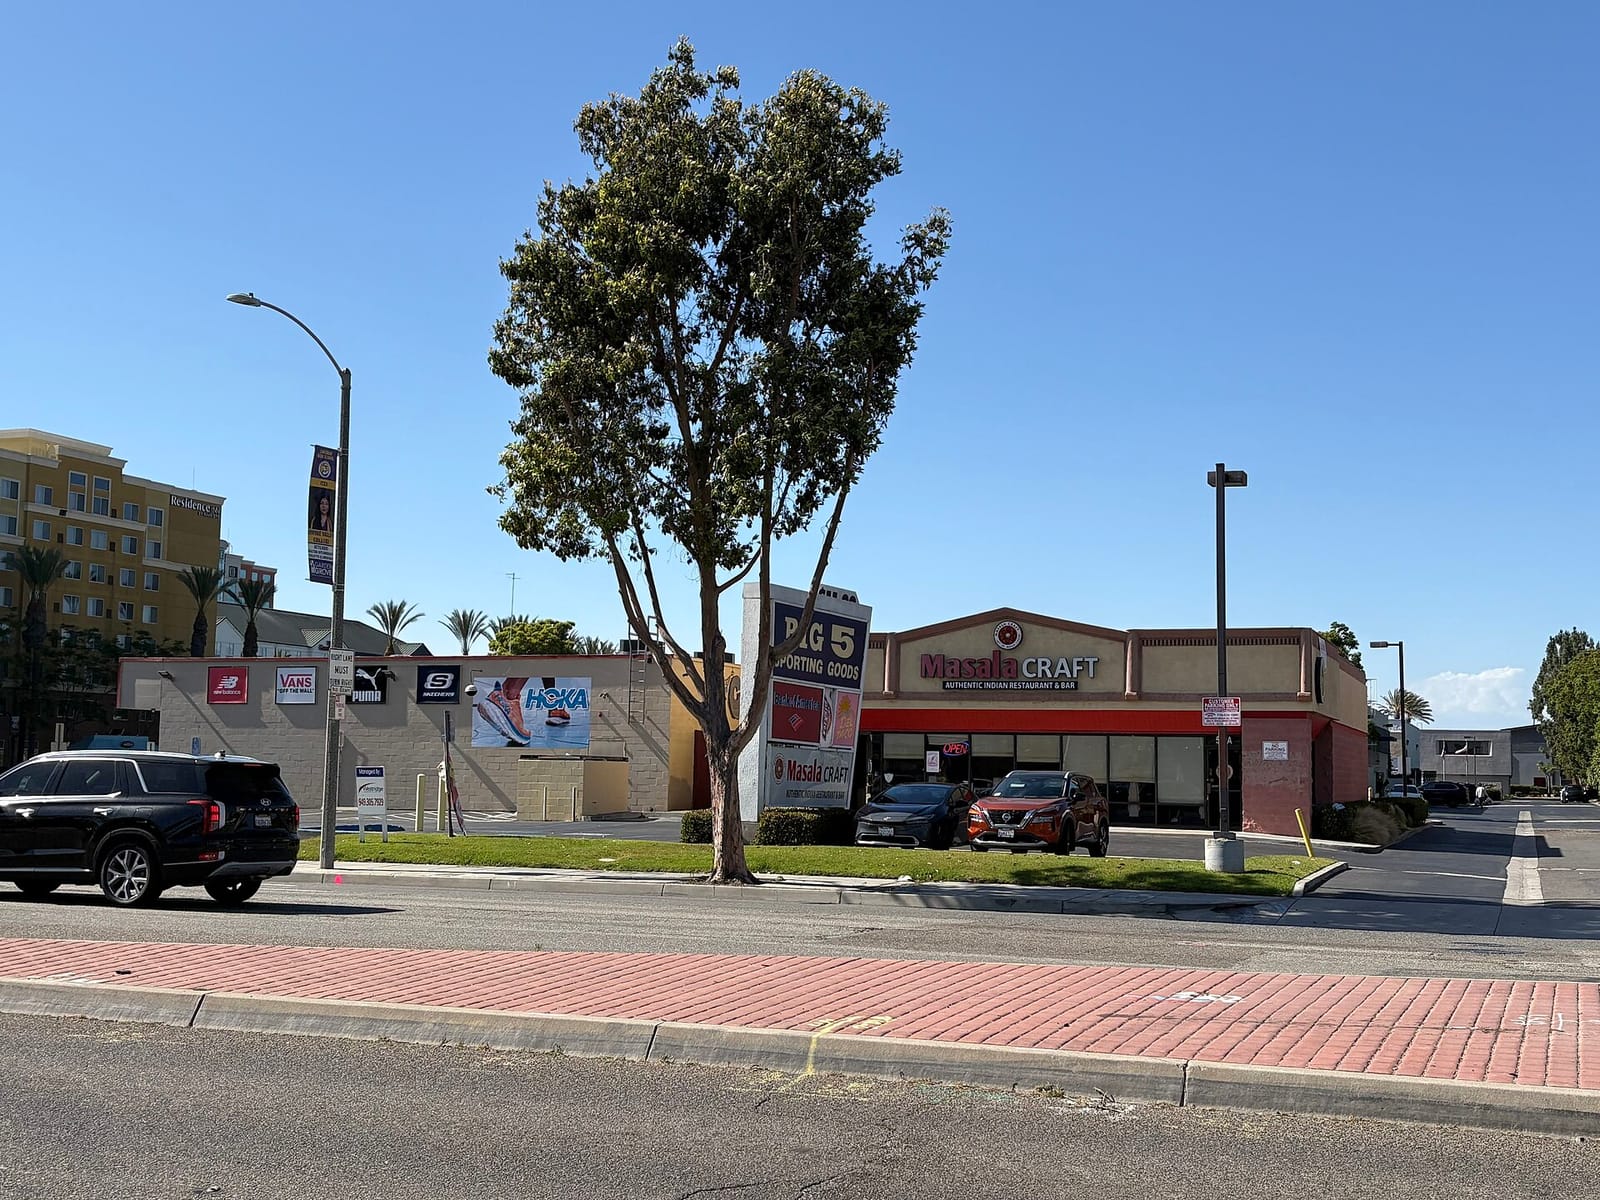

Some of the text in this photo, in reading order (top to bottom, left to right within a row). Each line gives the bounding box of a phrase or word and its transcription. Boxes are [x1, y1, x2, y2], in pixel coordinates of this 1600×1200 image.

[171, 495, 211, 512] Residence
[830, 624, 855, 659] 5
[334, 665, 349, 674] MUST
[827, 661, 859, 680] GOODS
[920, 650, 1099, 679] Masala CRAFT
[280, 674, 313, 687] VANS
[352, 690, 381, 702] PUMA
[525, 688, 590, 710] HOKA
[943, 743, 968, 754] OPEN
[786, 758, 849, 784] Masala CRAFT
